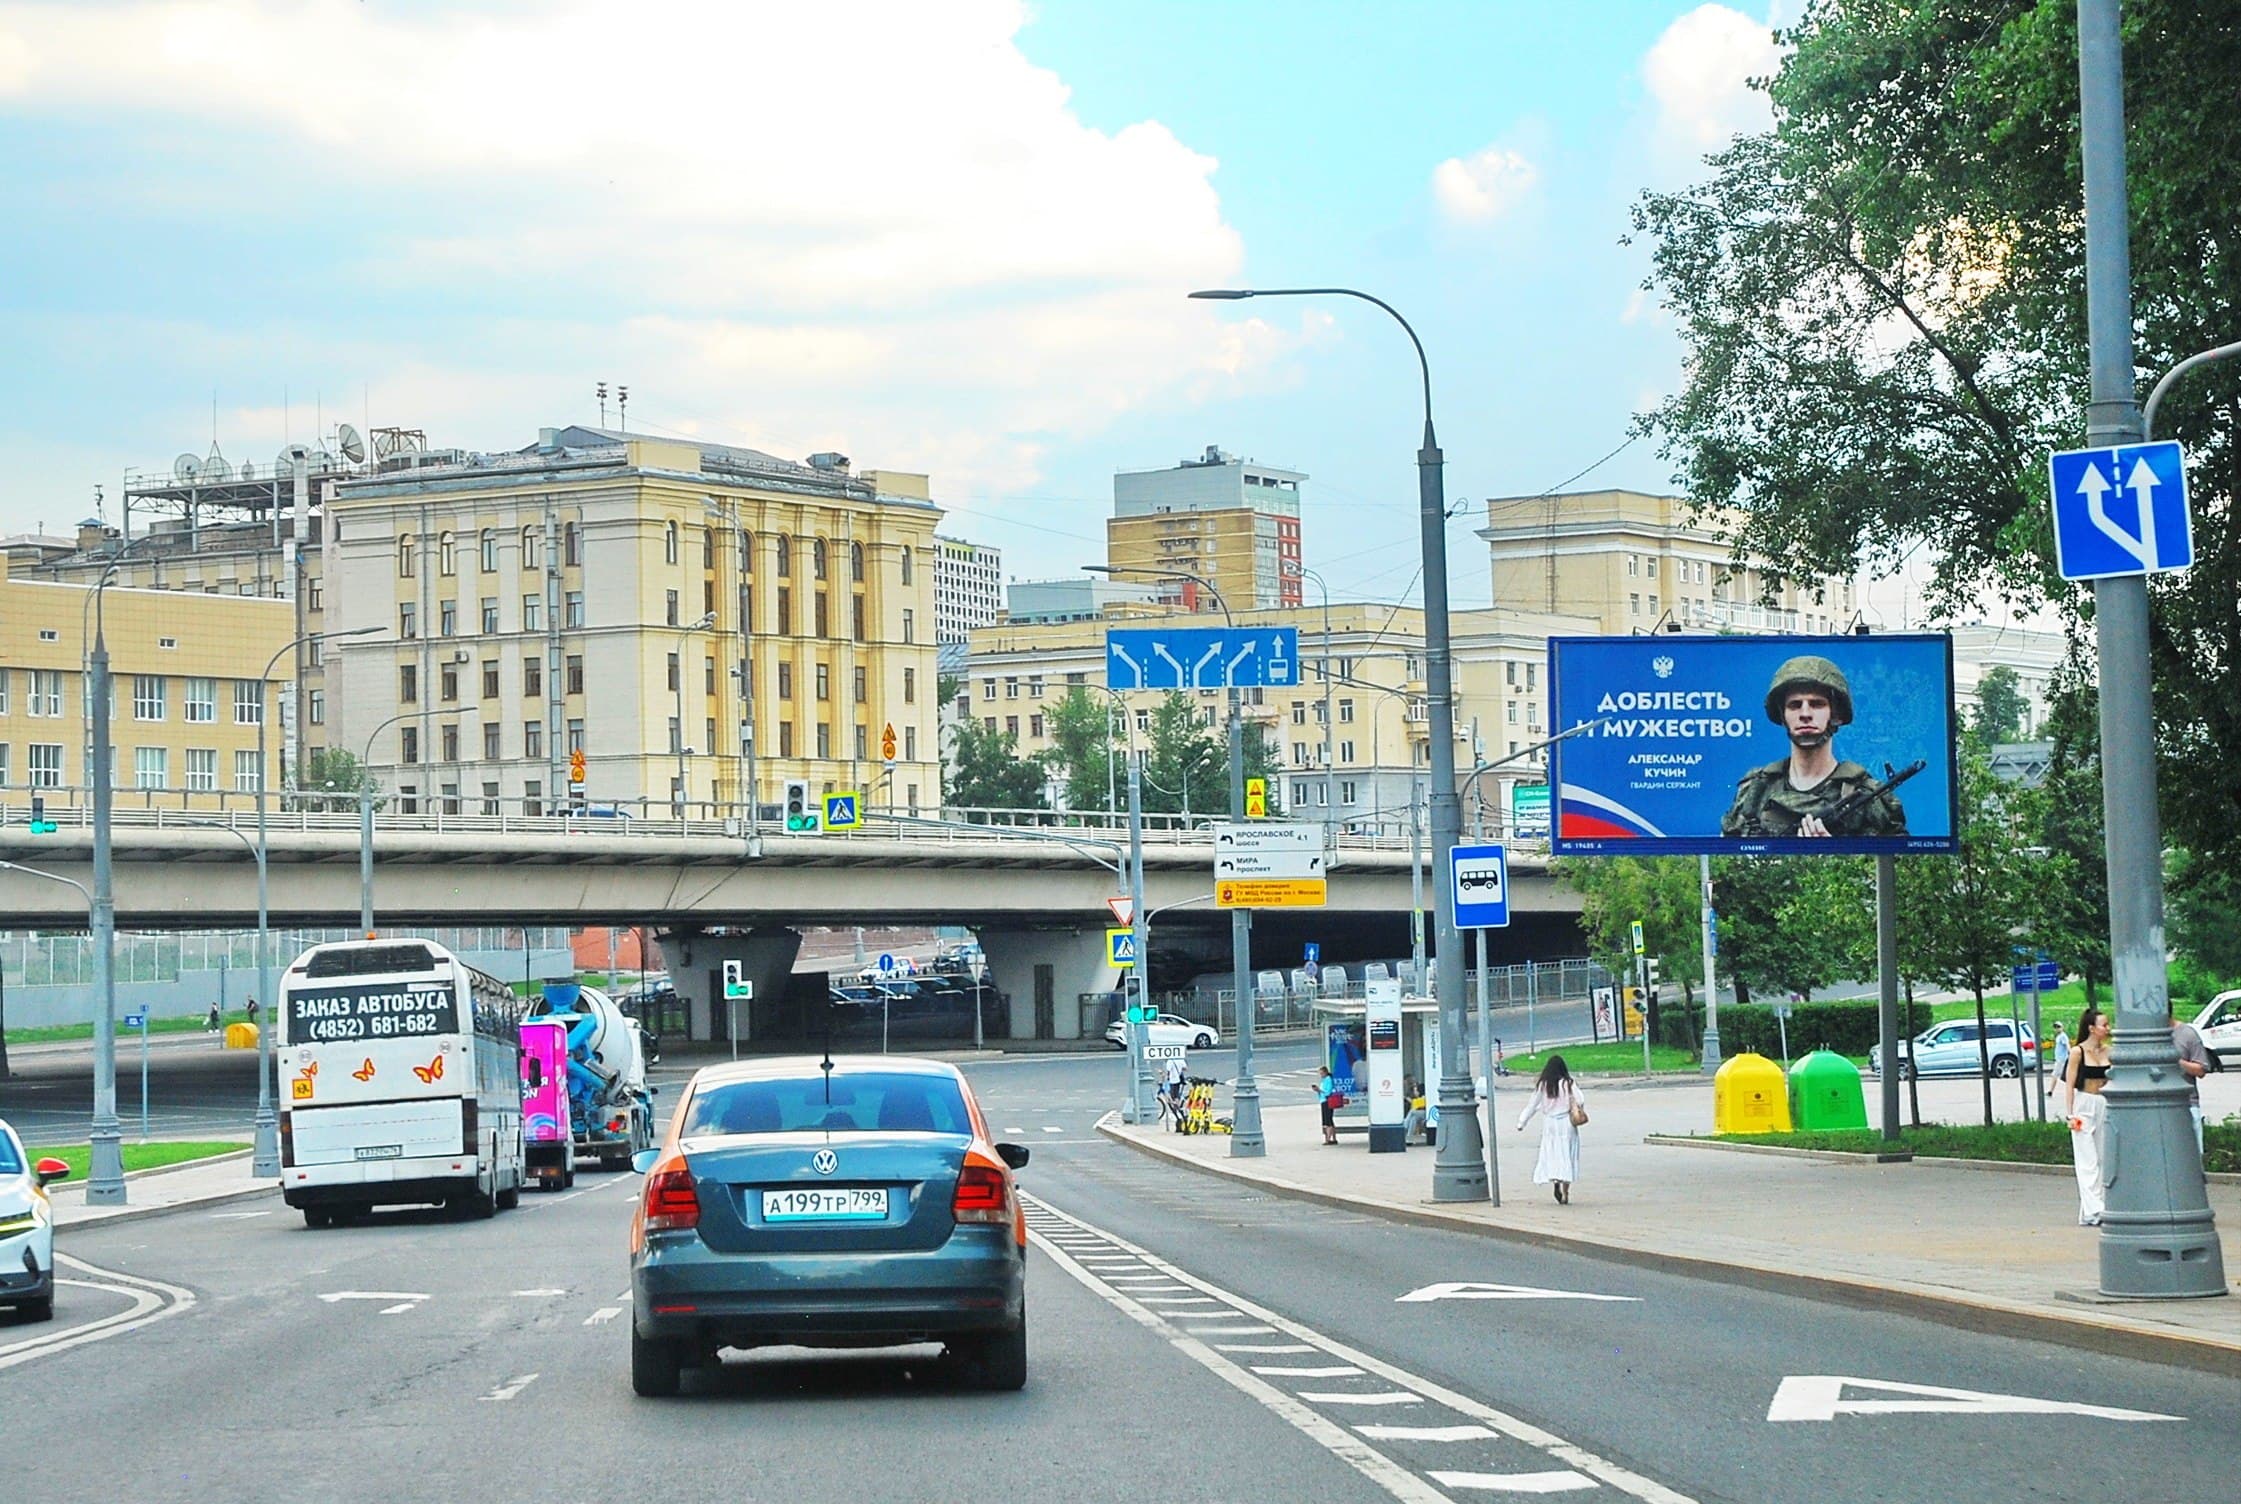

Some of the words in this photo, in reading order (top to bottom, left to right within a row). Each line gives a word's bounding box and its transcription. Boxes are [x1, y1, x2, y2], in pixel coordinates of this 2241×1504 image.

[1597, 691, 1731, 713] ДОБЛЕСТЬ
[1602, 718, 1752, 738] МУЖЕСТВО!
[1628, 754, 1703, 765] АЛЕКСАНДР
[1644, 767, 1687, 778] КУЧИН
[1630, 781, 1665, 790] ГВАРДИИ
[1666, 781, 1701, 789] СЕРЖАНТ
[1236, 830, 1294, 838] ЯРОСЛАВСКОЕ
[296, 998, 350, 1018] ЗАКАЗ
[356, 991, 449, 1014] АВТОБУСА
[309, 1018, 365, 1040] (4852)
[371, 1013, 437, 1035] 681-682
[1148, 1047, 1181, 1058] СТОП
[852, 1191, 882, 1206] 799
